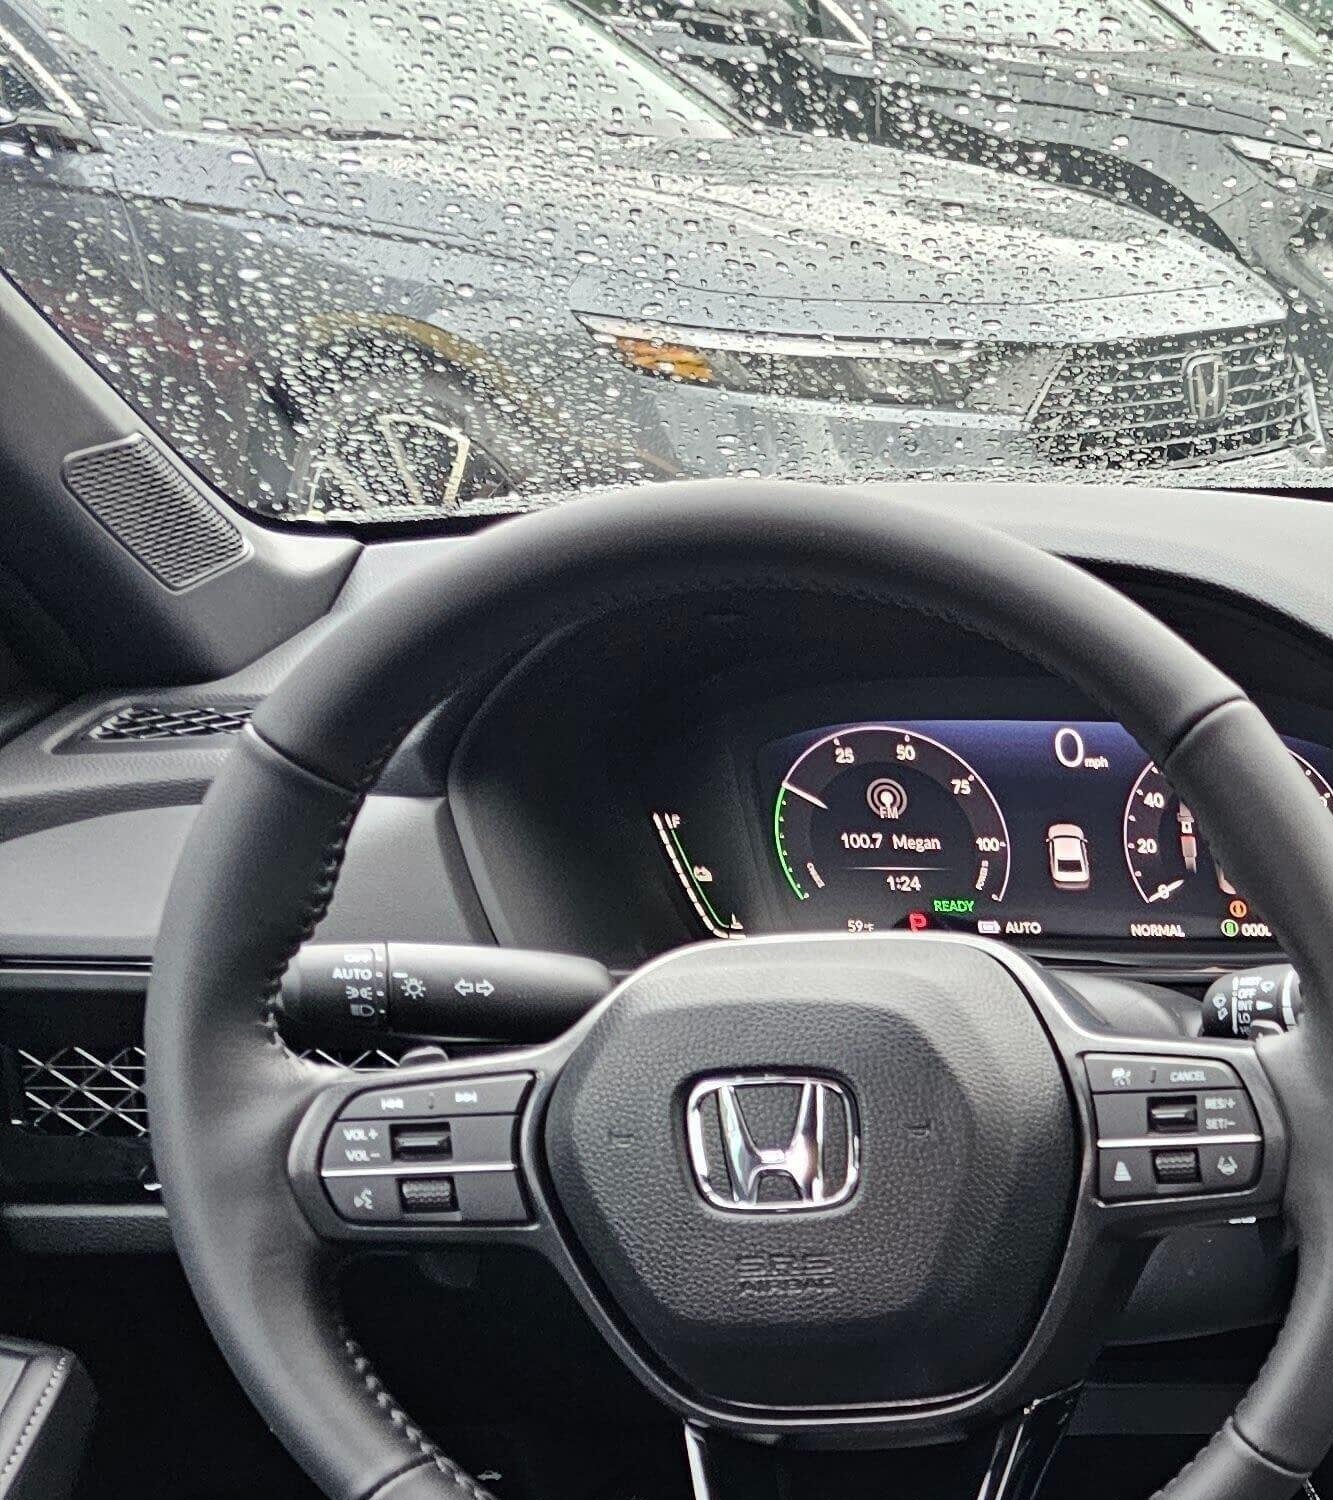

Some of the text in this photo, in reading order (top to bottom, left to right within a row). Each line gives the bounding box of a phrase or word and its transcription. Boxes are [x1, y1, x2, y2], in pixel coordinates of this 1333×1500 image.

[835, 747, 855, 763] 25
[896, 745, 916, 761] 50
[1054, 728, 1108, 769] 0 mph
[951, 779, 971, 795] 75
[1143, 792, 1164, 808] 40
[880, 807, 898, 819] FM
[840, 833, 941, 853] 100.7 Megan
[976, 837, 1000, 852] 100
[1137, 839, 1158, 854] 20
[886, 875, 922, 891] 1:24
[934, 900, 975, 912] READY
[909, 912, 928, 932] P
[1005, 922, 1042, 934] AUTO
[1130, 923, 1186, 938] NORMAL
[332, 968, 373, 981] AUTO
[1170, 1070, 1206, 1082] CANCEL
